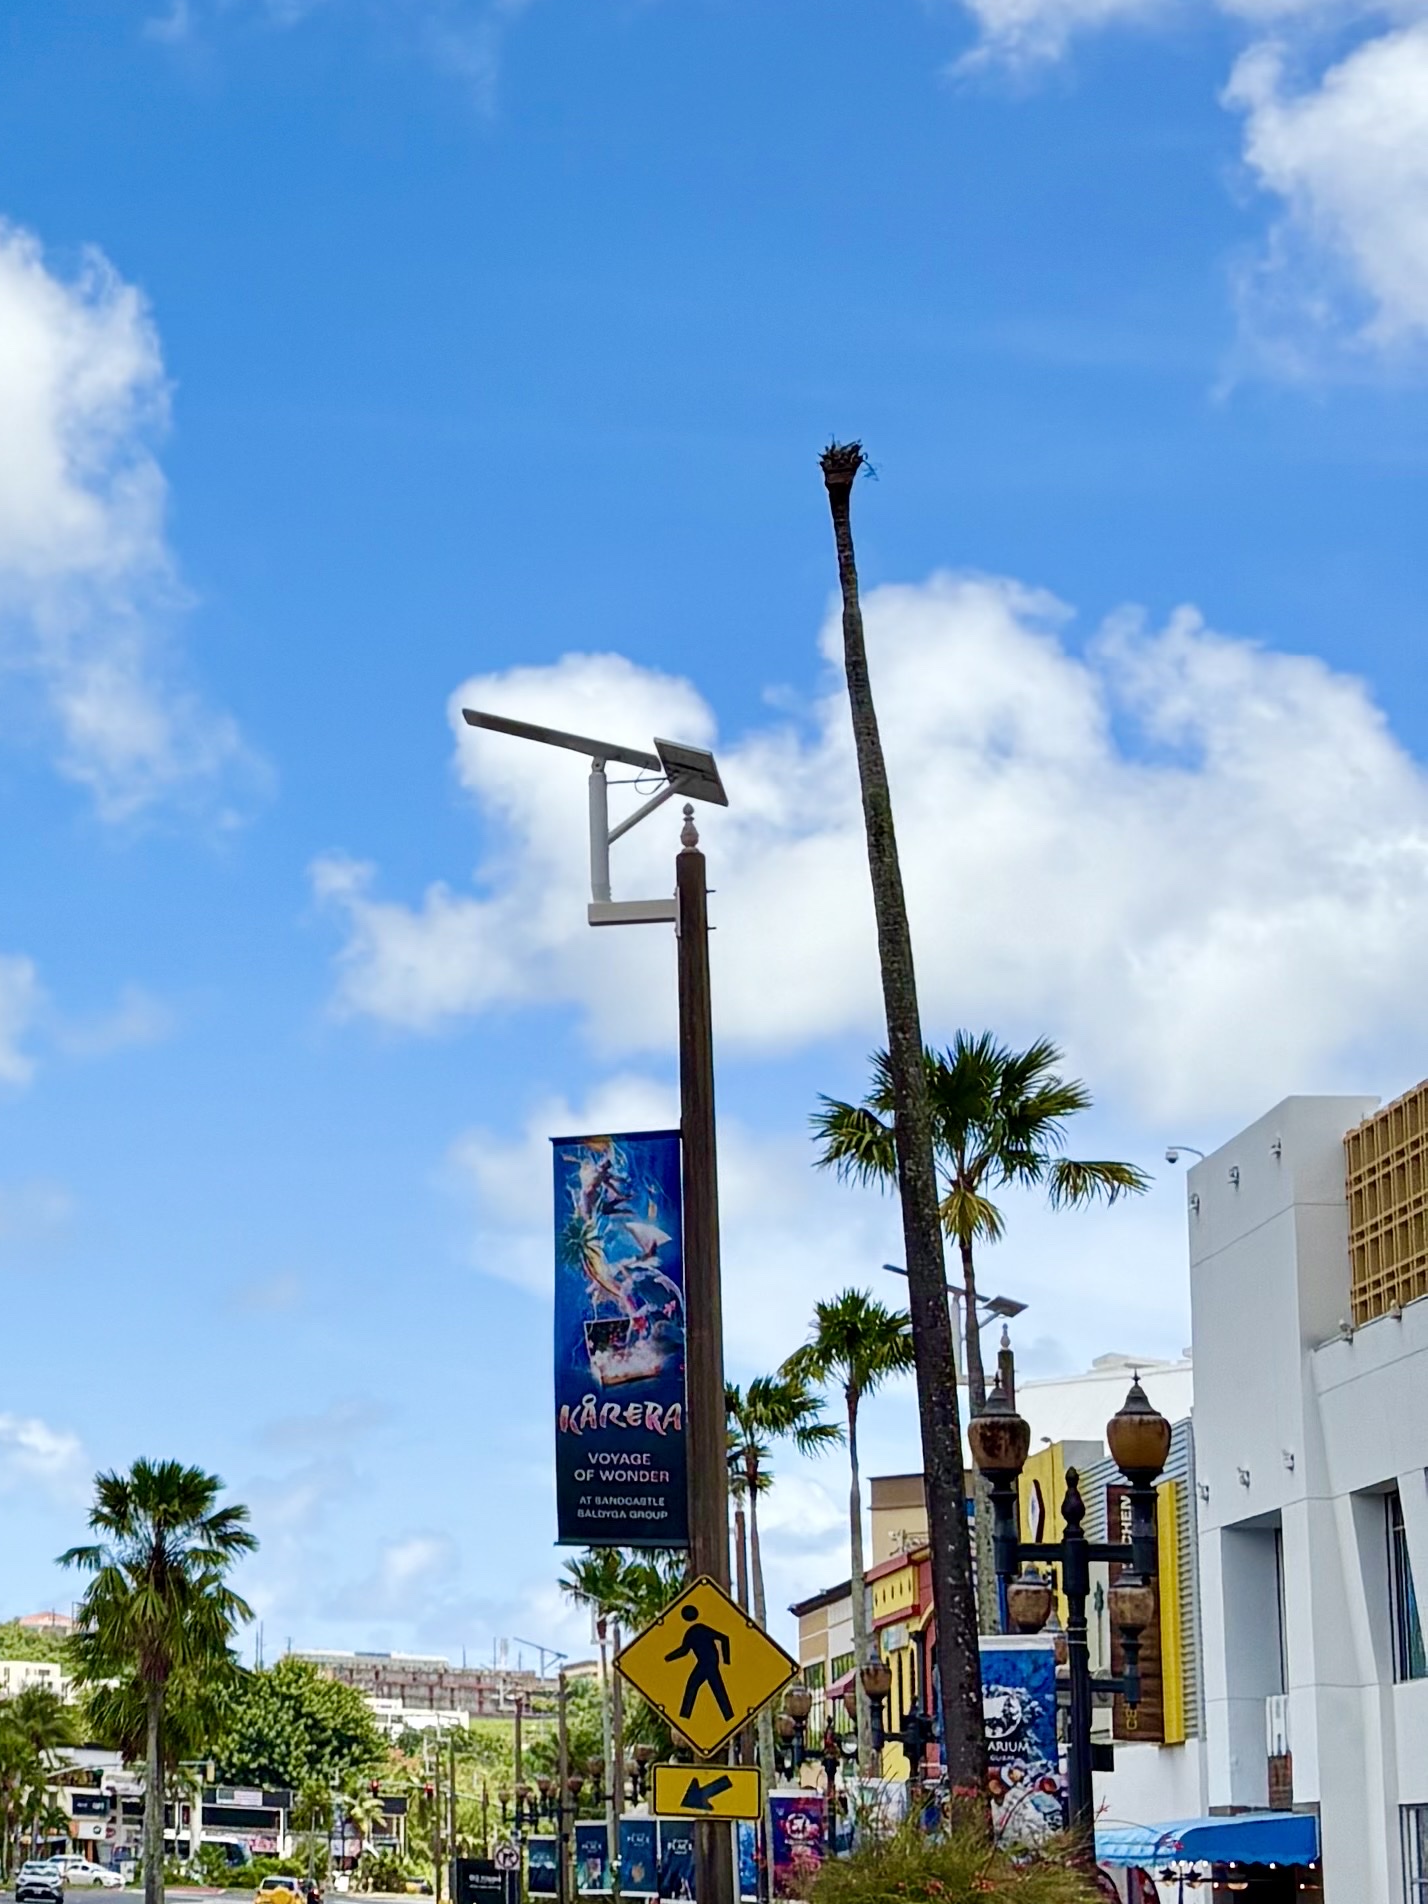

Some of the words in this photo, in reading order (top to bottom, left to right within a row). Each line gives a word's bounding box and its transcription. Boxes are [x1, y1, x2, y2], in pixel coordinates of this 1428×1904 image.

[588, 1452, 651, 1466] VOYAGE
[574, 1469, 595, 1482] OF
[599, 1469, 670, 1483] WONDER
[579, 1496, 592, 1506] AT
[629, 1510, 669, 1520] GROUP
[987, 1740, 1033, 1755] ARIUM
